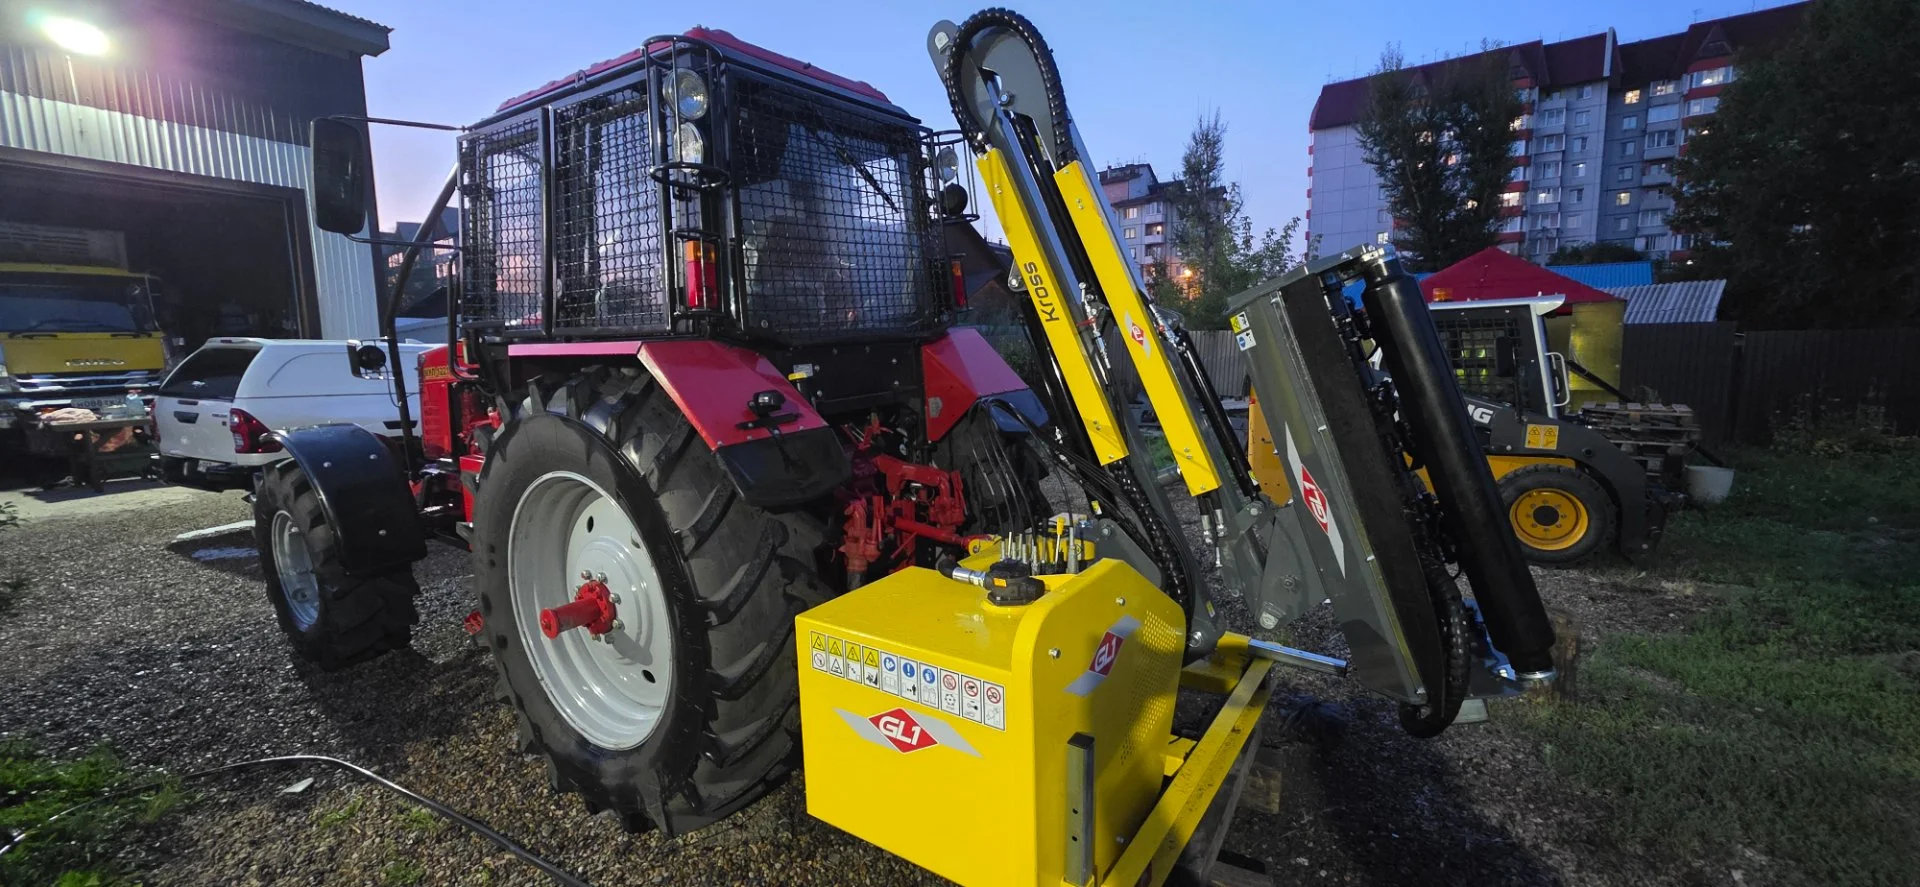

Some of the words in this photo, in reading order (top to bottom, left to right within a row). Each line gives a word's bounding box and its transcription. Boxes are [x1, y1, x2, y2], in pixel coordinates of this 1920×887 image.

[1024, 261, 1060, 322] Kross
[1303, 481, 1328, 523] GL1
[1095, 636, 1117, 672] GL1
[879, 716, 922, 746] GL1
